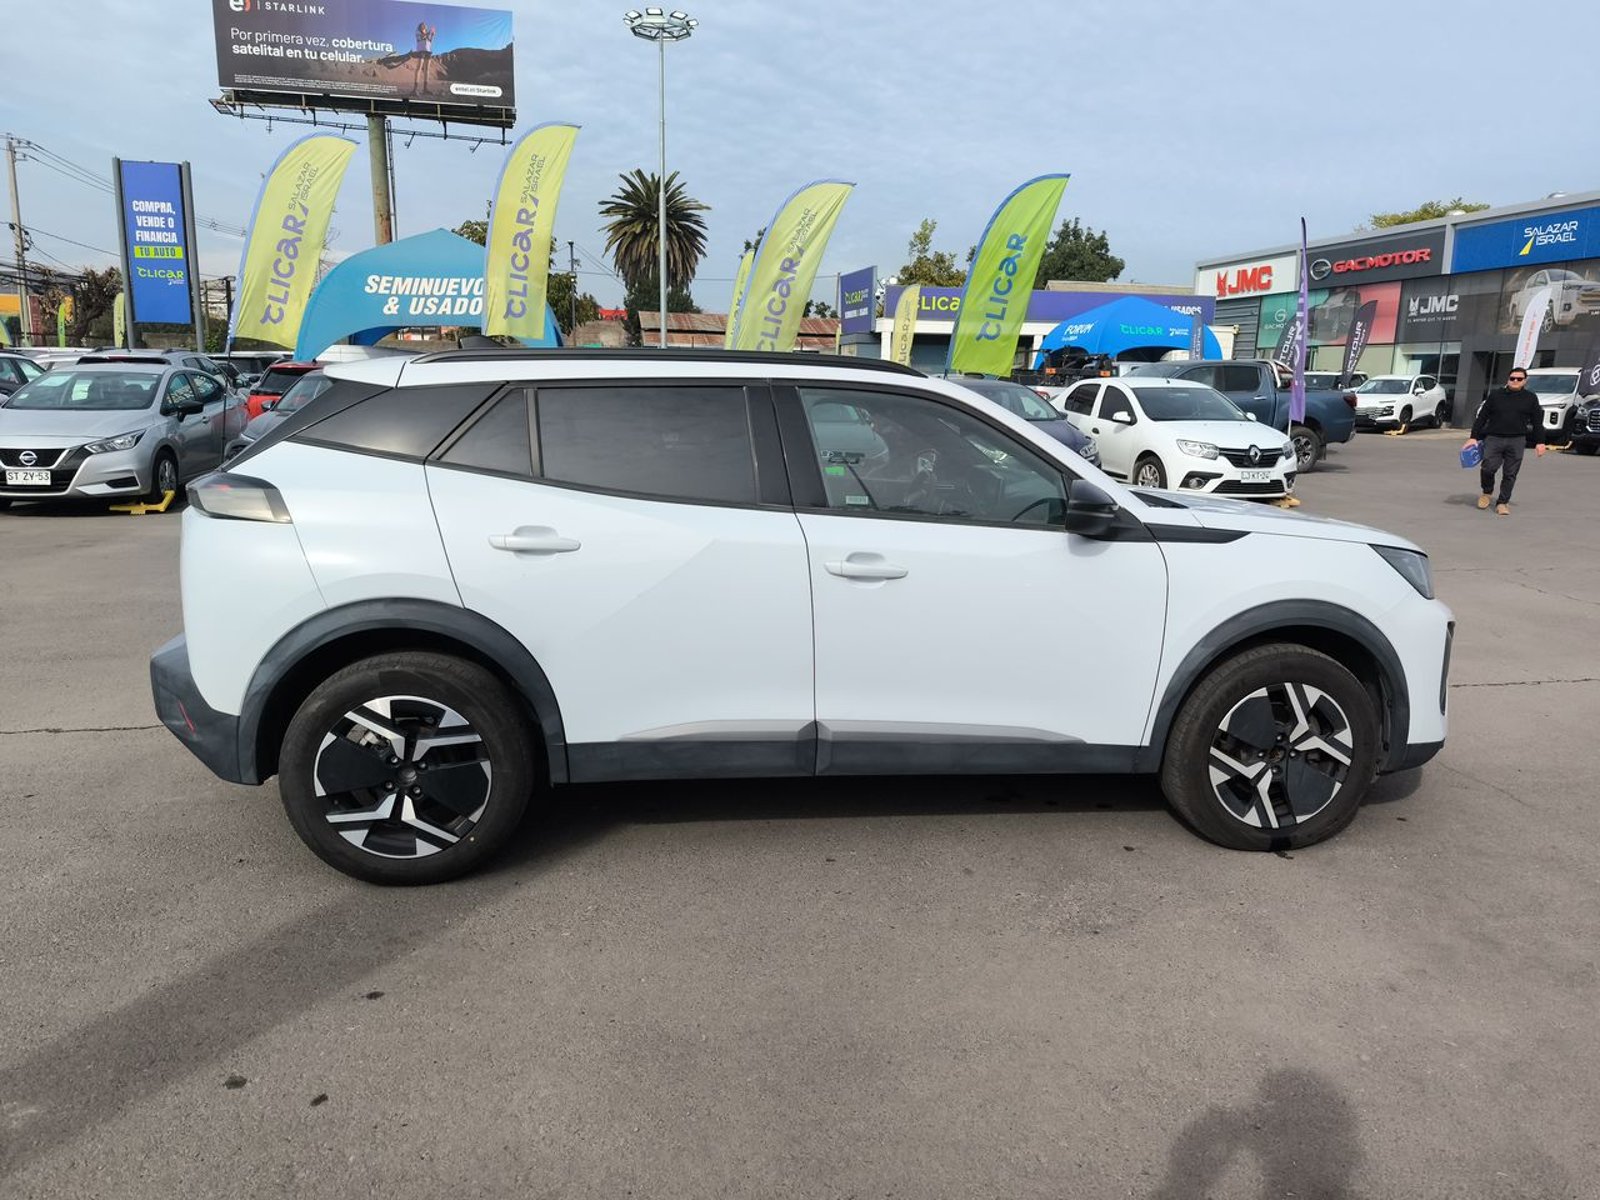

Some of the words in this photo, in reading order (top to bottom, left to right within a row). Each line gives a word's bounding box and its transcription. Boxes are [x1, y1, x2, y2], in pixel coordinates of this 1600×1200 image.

[265, 2, 325, 15] STARLINK
[231, 27, 251, 40] Por
[255, 31, 303, 45] primera
[305, 36, 330, 48] vez,
[332, 37, 393, 52] cobertura
[232, 44, 283, 57] satelital
[286, 48, 302, 58] en
[304, 50, 318, 60] tu
[320, 50, 365, 64] celular.
[520, 153, 539, 204] SALAZAR
[530, 156, 545, 192] ISRAEL
[288, 162, 311, 211] SALAZAR
[300, 167, 319, 201] ISRAEL
[132, 200, 176, 214] COMPRA,
[136, 215, 166, 228] VENDE
[168, 217, 174, 228] O
[1524, 221, 1579, 237] SALAZAR
[135, 230, 178, 243] FINANCIA
[1536, 232, 1576, 246] ISRAEL
[139, 247, 150, 256] TU
[154, 247, 176, 257] AUTO
[1228, 265, 1273, 295] JMC
[383, 298, 399, 316] &
[1420, 294, 1459, 313] JMC
[8, 472, 19, 481] ST
